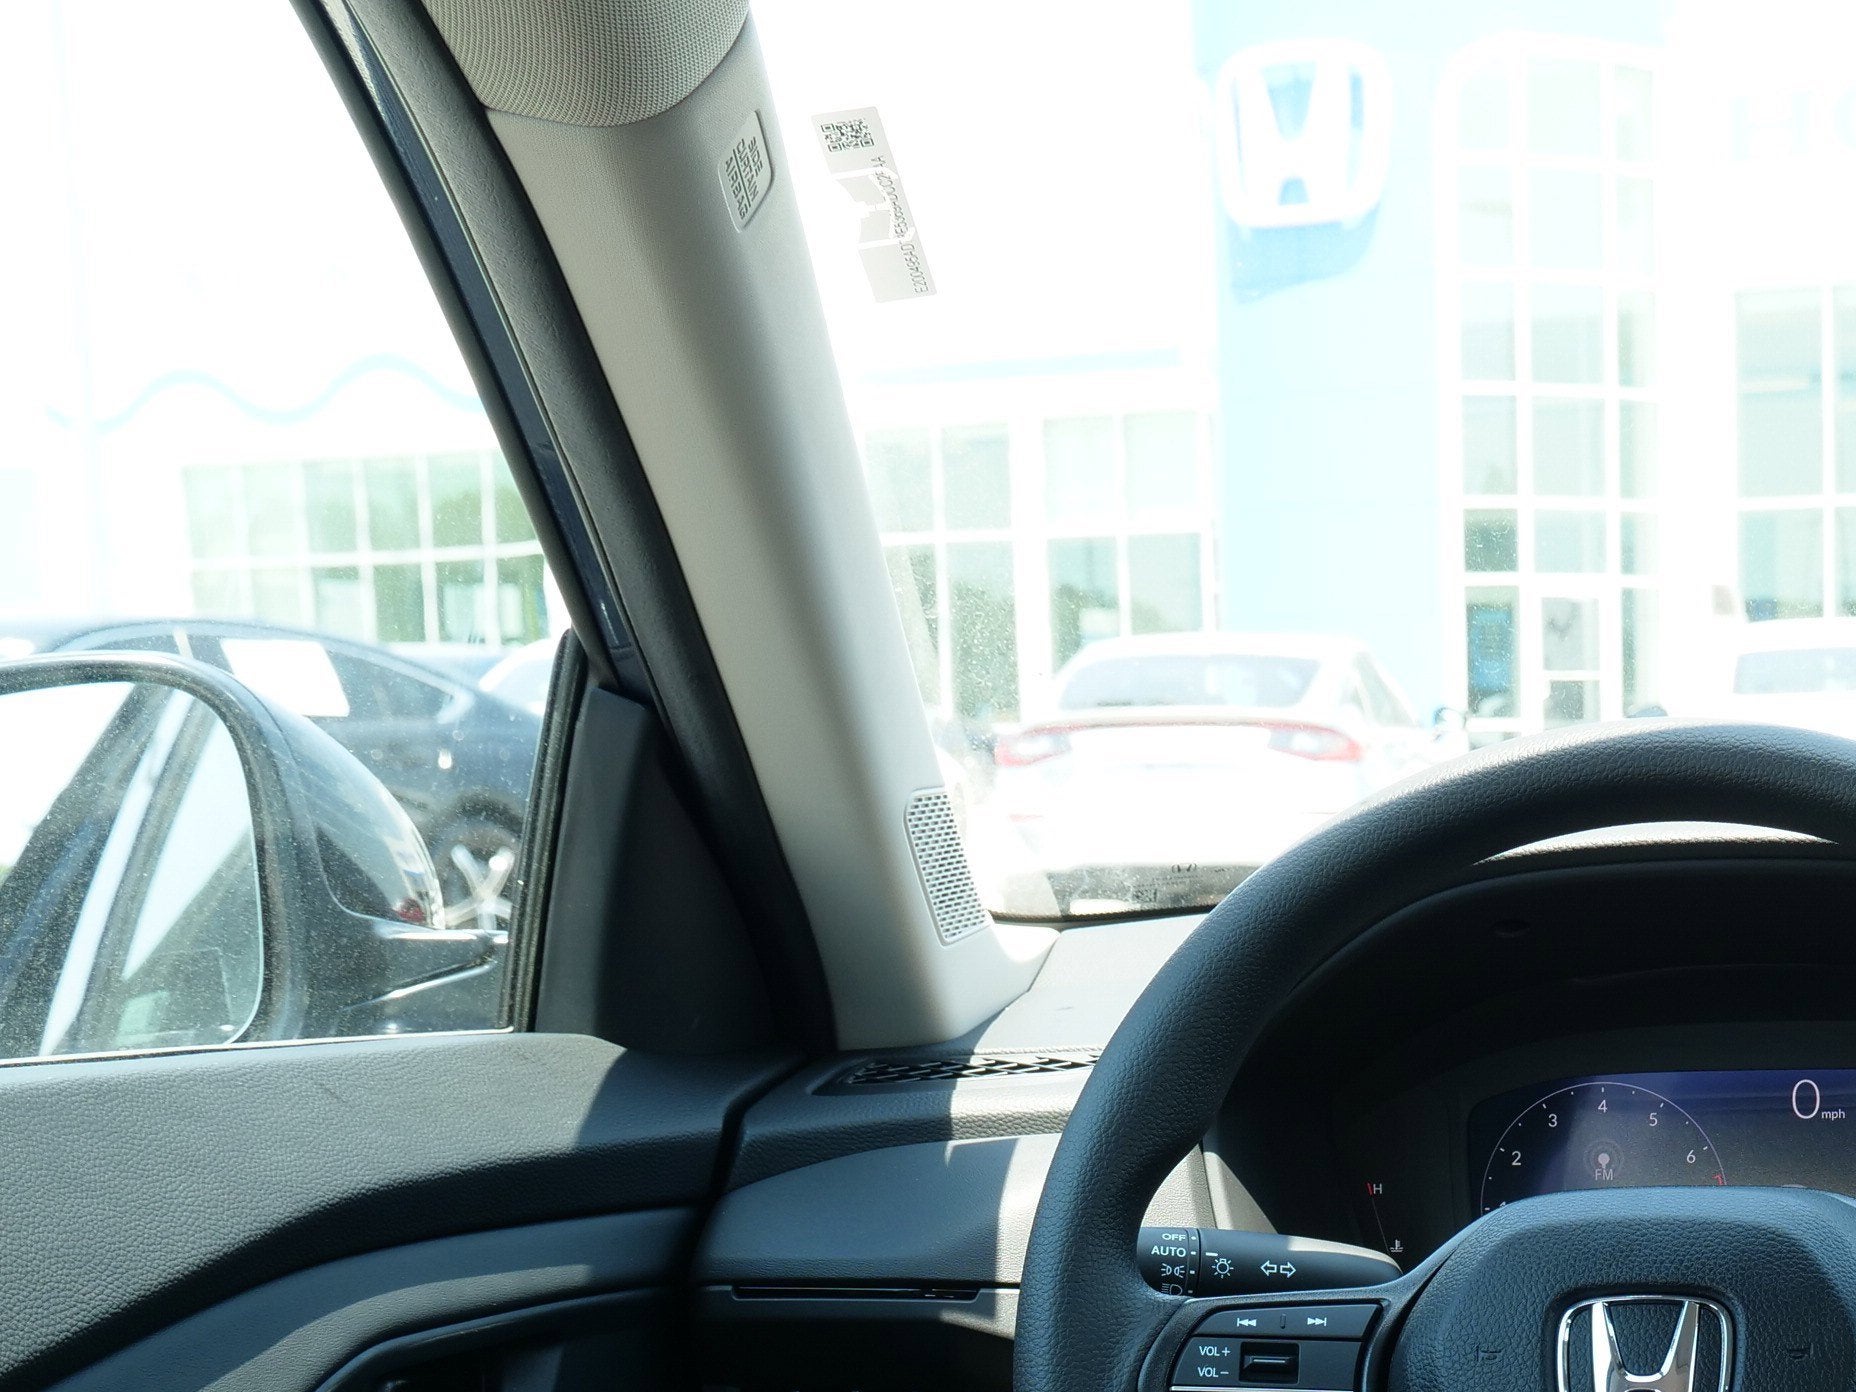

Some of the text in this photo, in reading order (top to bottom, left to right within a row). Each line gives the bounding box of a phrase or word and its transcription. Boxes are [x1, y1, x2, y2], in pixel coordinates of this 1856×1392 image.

[748, 136, 763, 177] SIDE
[736, 138, 759, 202] CURTAIN
[726, 156, 748, 220] AIRBAG
[1597, 1100, 1608, 1113] 4
[1792, 1079, 1846, 1121] 0 mph
[1548, 1114, 1558, 1127] 3
[1649, 1113, 1658, 1127] 5
[1512, 1151, 1522, 1166] 2
[1686, 1150, 1696, 1164] 6
[1595, 1169, 1613, 1180] FM
[1373, 1183, 1382, 1194] H
[1161, 1233, 1186, 1241] OFF
[1151, 1245, 1186, 1257] AUTO
